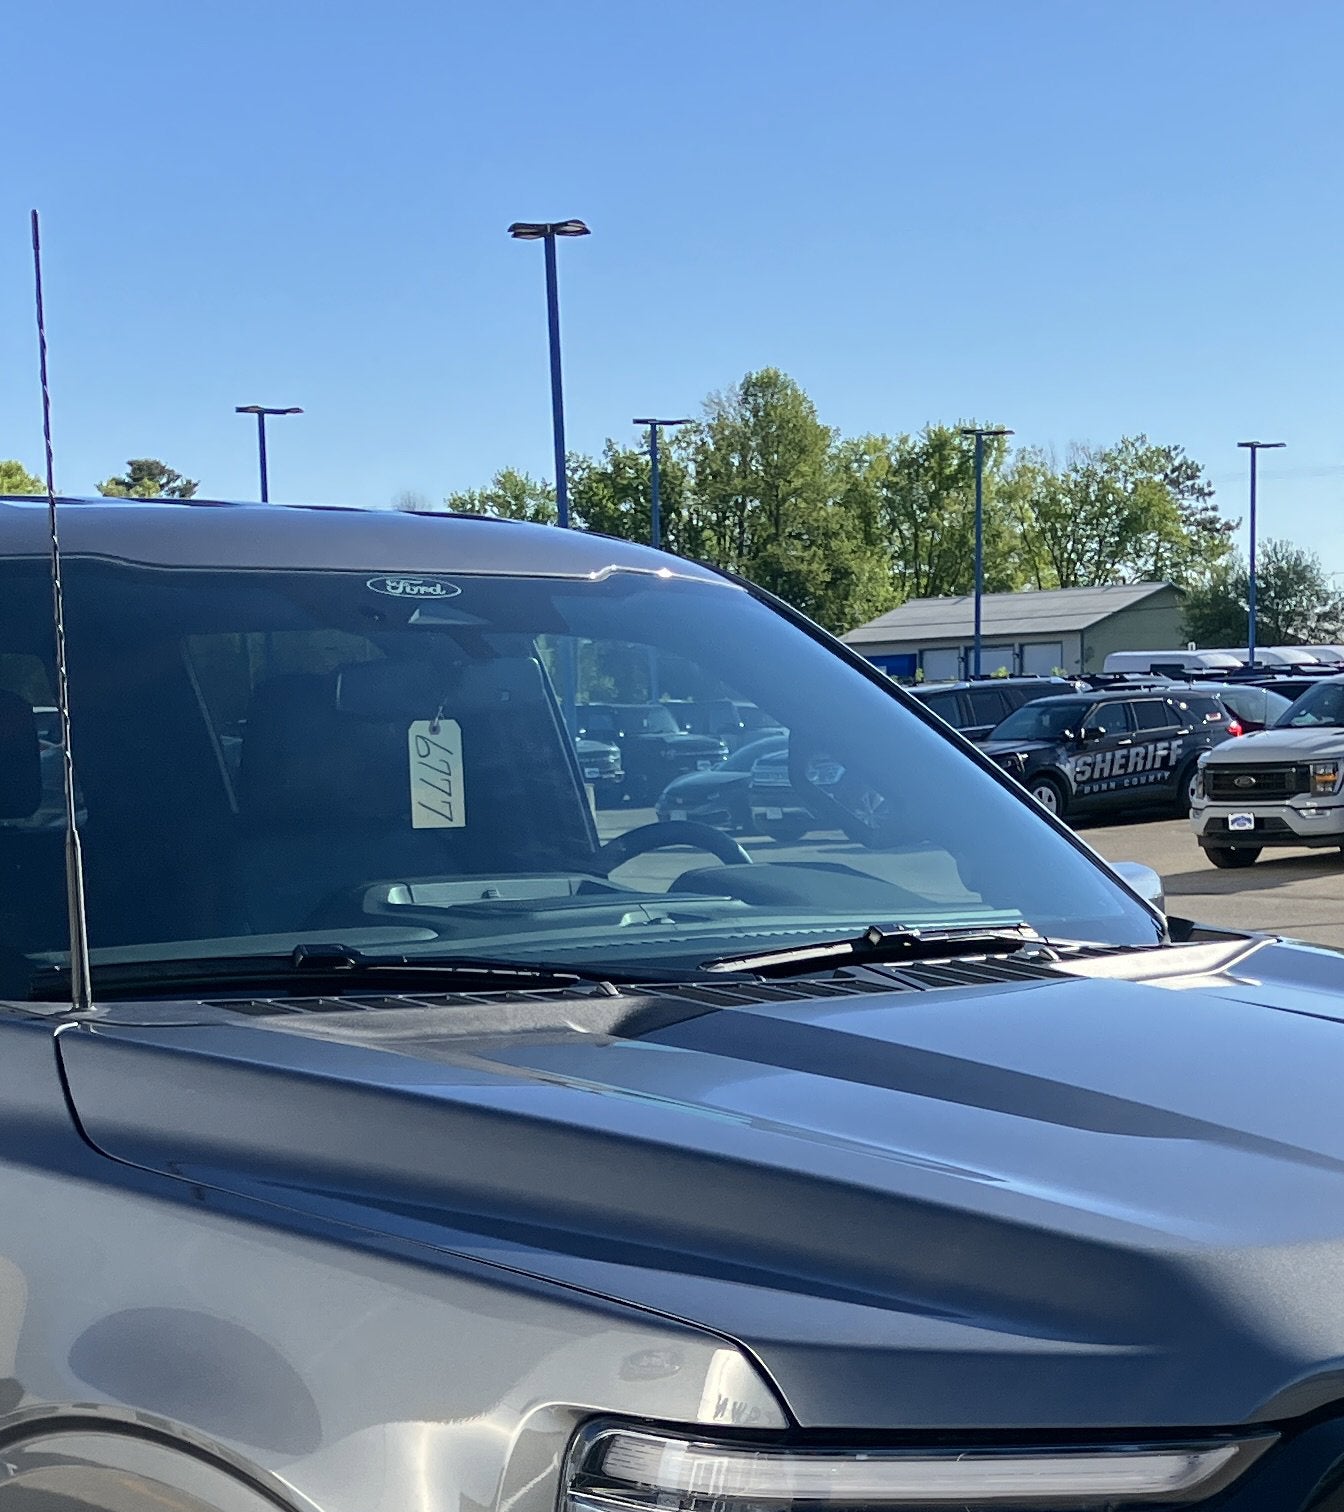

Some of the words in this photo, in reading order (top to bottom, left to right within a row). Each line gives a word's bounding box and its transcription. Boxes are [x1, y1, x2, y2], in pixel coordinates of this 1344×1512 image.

[385, 579, 446, 595] Ford
[1076, 740, 1183, 781] SHERIFF
[416, 735, 454, 822] 6777
[1123, 771, 1171, 787] COUNTY
